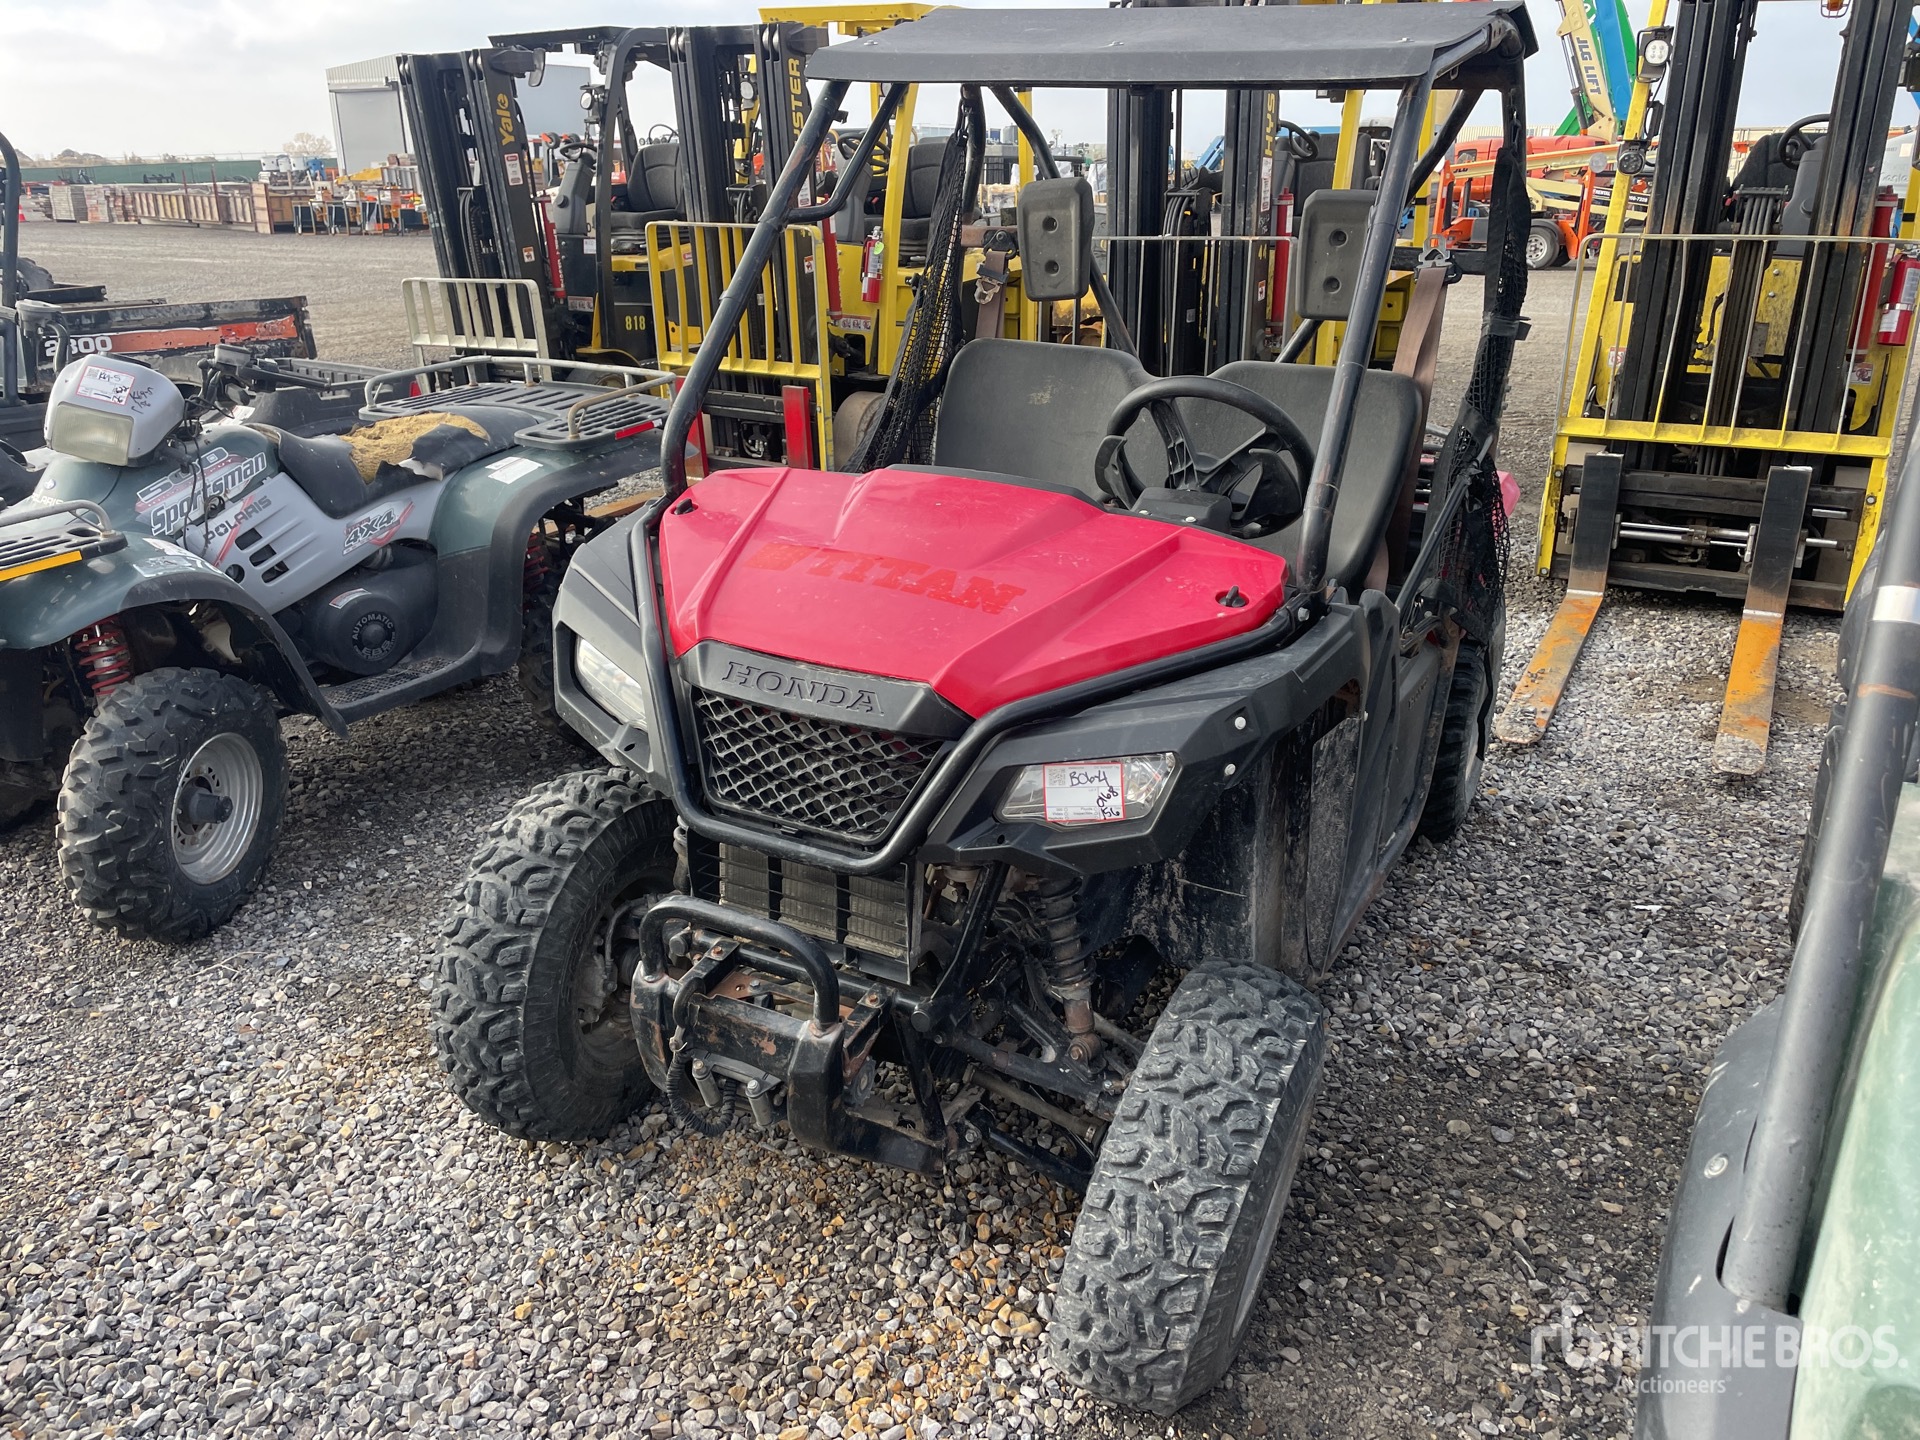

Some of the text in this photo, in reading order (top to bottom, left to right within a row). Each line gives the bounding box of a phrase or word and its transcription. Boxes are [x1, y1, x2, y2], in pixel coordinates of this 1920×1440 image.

[1575, 37, 1593, 61] JLG
[788, 57, 804, 147] STER
[1583, 65, 1602, 94] LIFT
[496, 93, 516, 146] Yale
[625, 315, 646, 331] 818
[150, 451, 267, 537] Sportsman
[202, 495, 273, 542] POLARIS
[343, 508, 397, 549] 4X4
[805, 546, 1028, 616] TITAN
[351, 613, 395, 641] AUTOMATIC
[721, 660, 886, 718] HONDA
